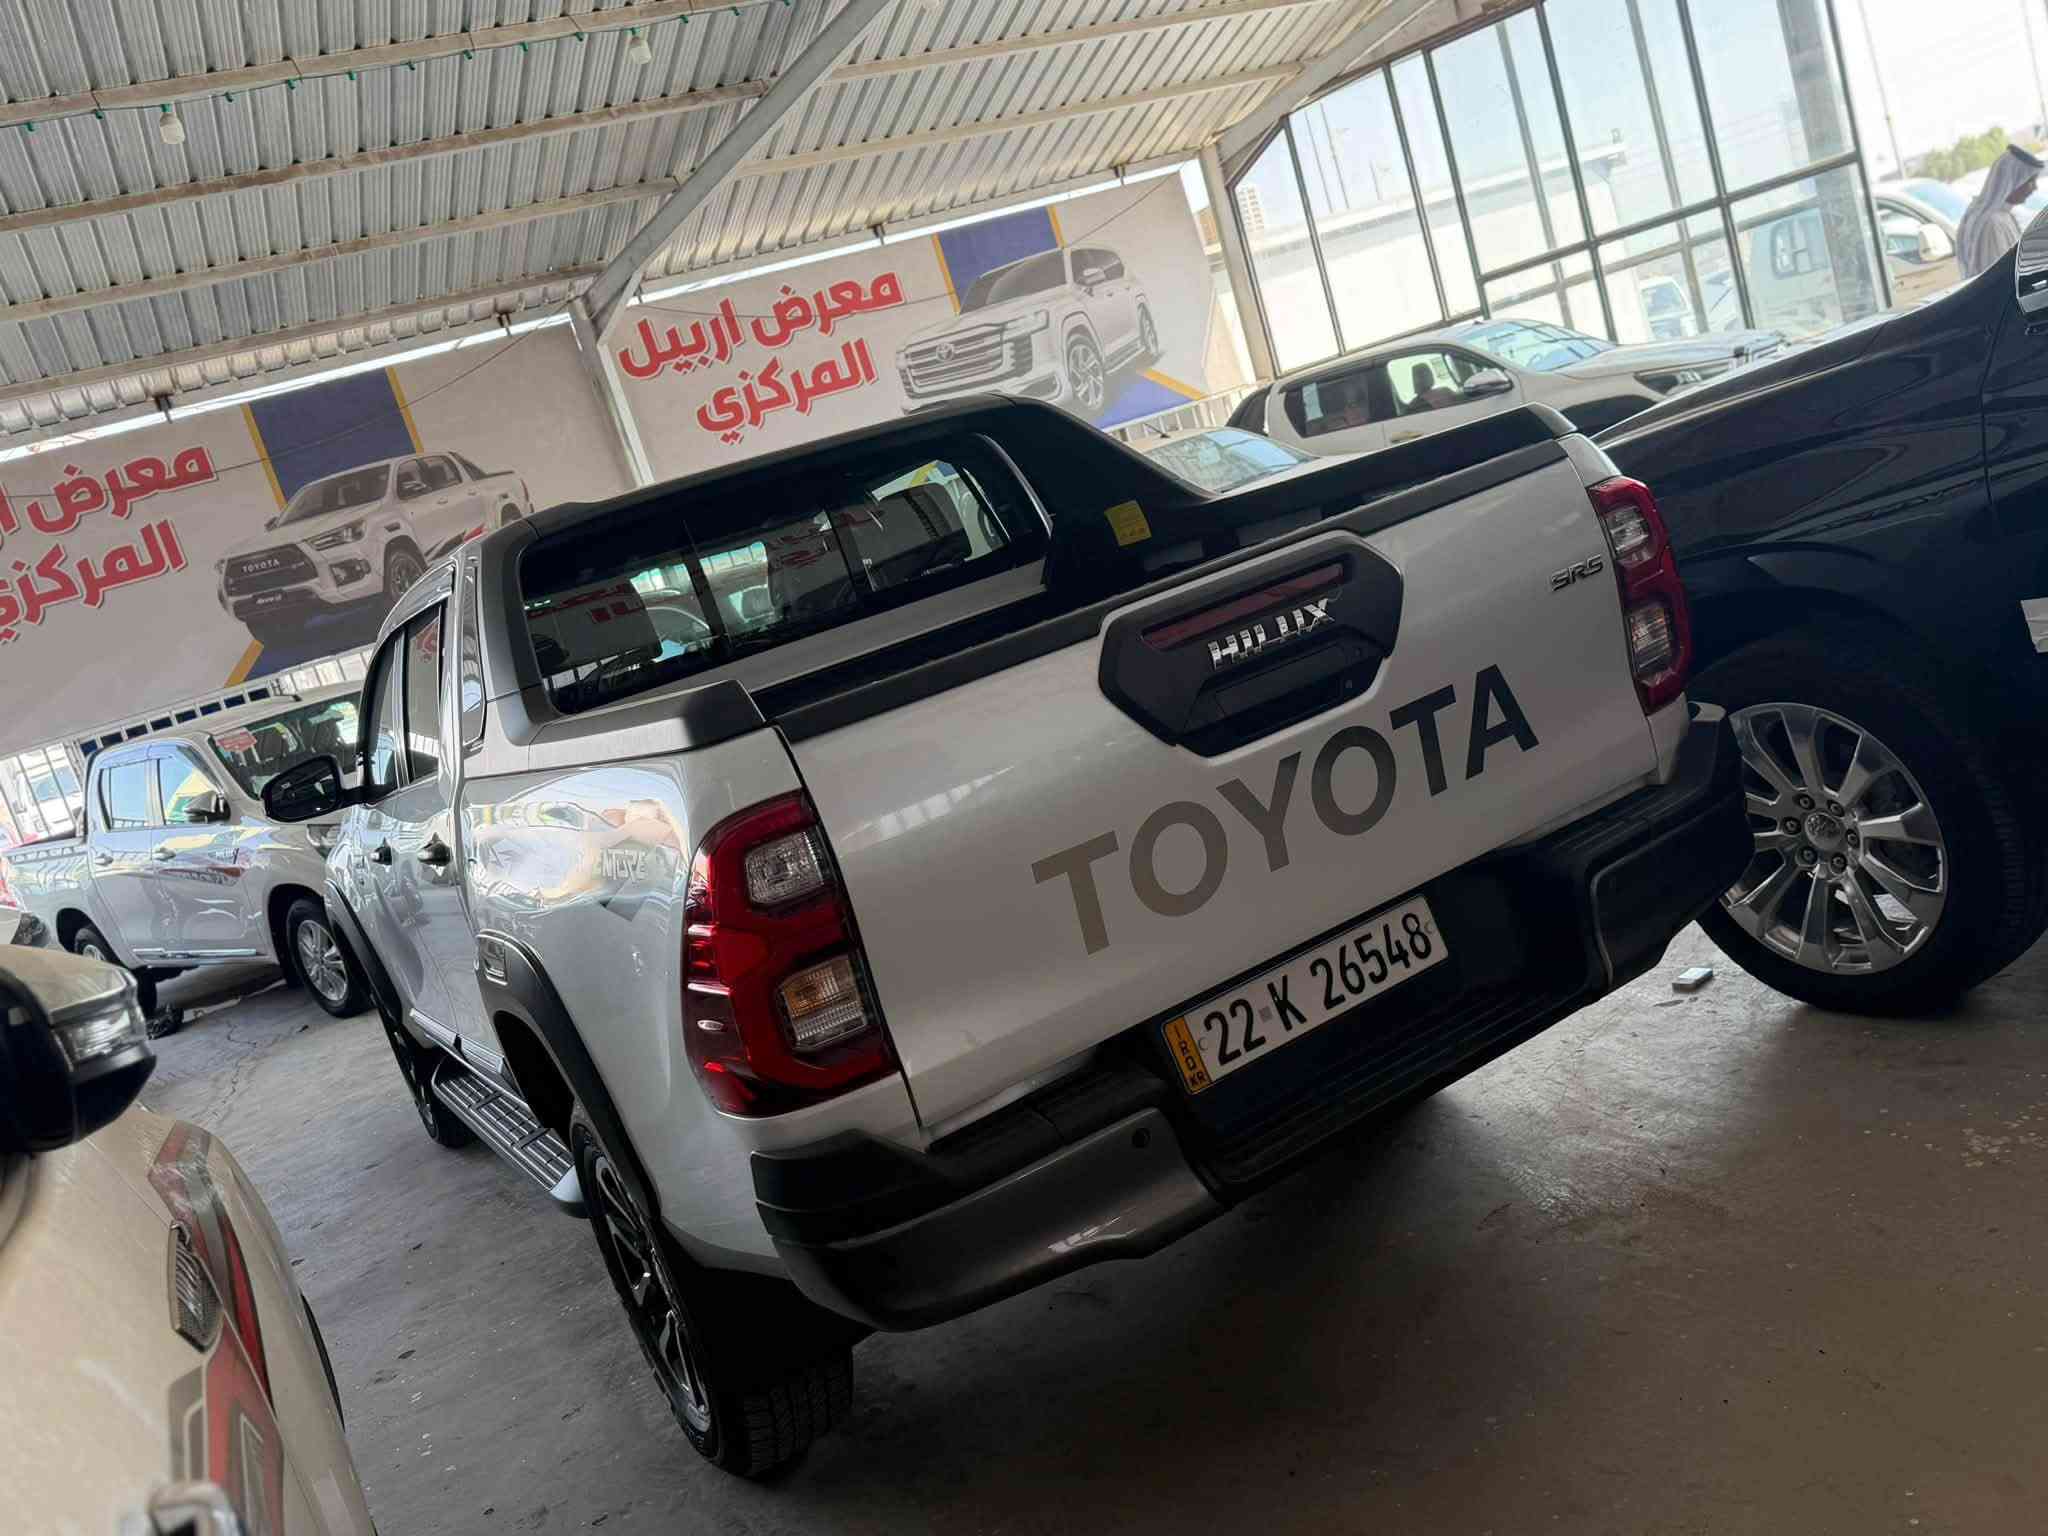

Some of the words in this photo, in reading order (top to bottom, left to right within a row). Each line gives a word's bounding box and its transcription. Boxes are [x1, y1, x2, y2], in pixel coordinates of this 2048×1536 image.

[618, 297, 741, 379] اربيل
[750, 271, 904, 348] معرض
[696, 337, 874, 445] المركزي
[26, 446, 216, 534] معرض
[242, 559, 280, 573] TOYOTA
[1207, 597, 1336, 671] HILUX
[1031, 663, 1540, 956] TOYOTA
[1203, 999, 1267, 1067] 22
[1267, 974, 1307, 1033] K
[1309, 912, 1432, 1011] 26548
